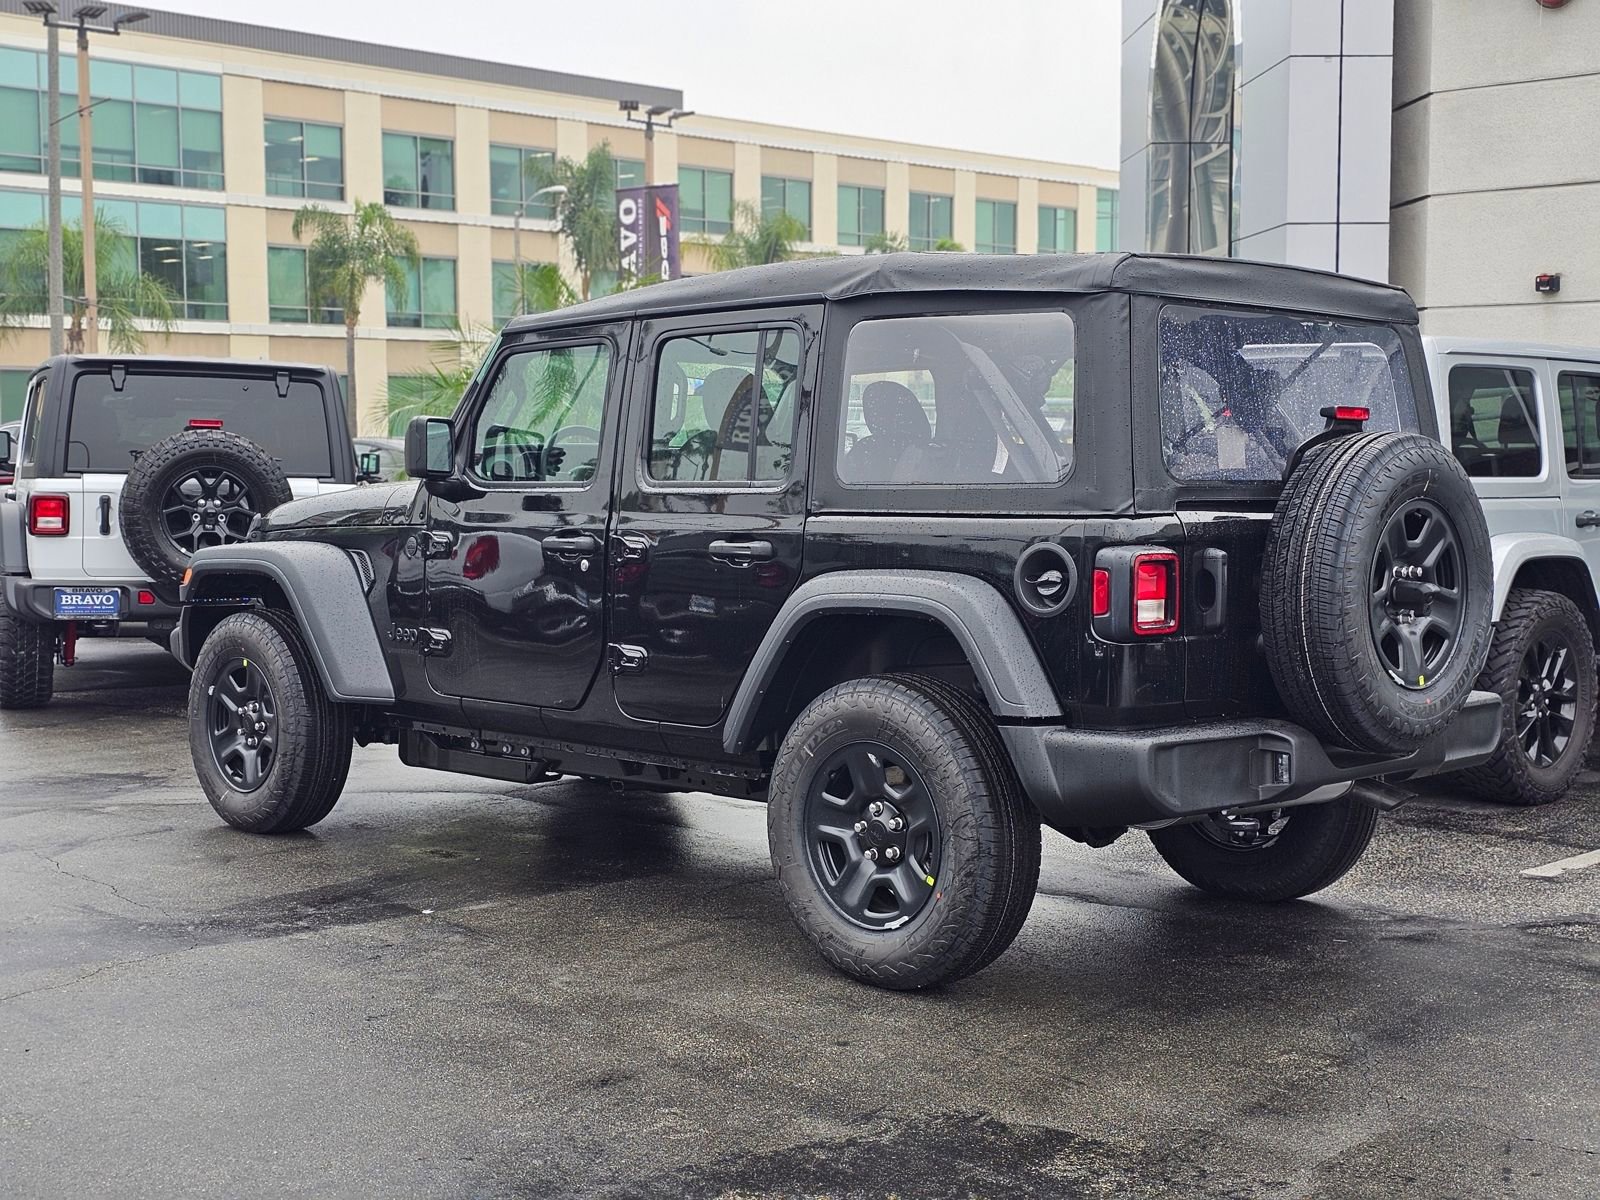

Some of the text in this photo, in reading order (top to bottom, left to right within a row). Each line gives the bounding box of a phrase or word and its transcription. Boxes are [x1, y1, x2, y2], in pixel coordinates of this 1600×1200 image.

[619, 198, 638, 290] AVO
[659, 216, 670, 280] DGE
[60, 594, 114, 605] BRAVO
[387, 622, 418, 645] Jeep
